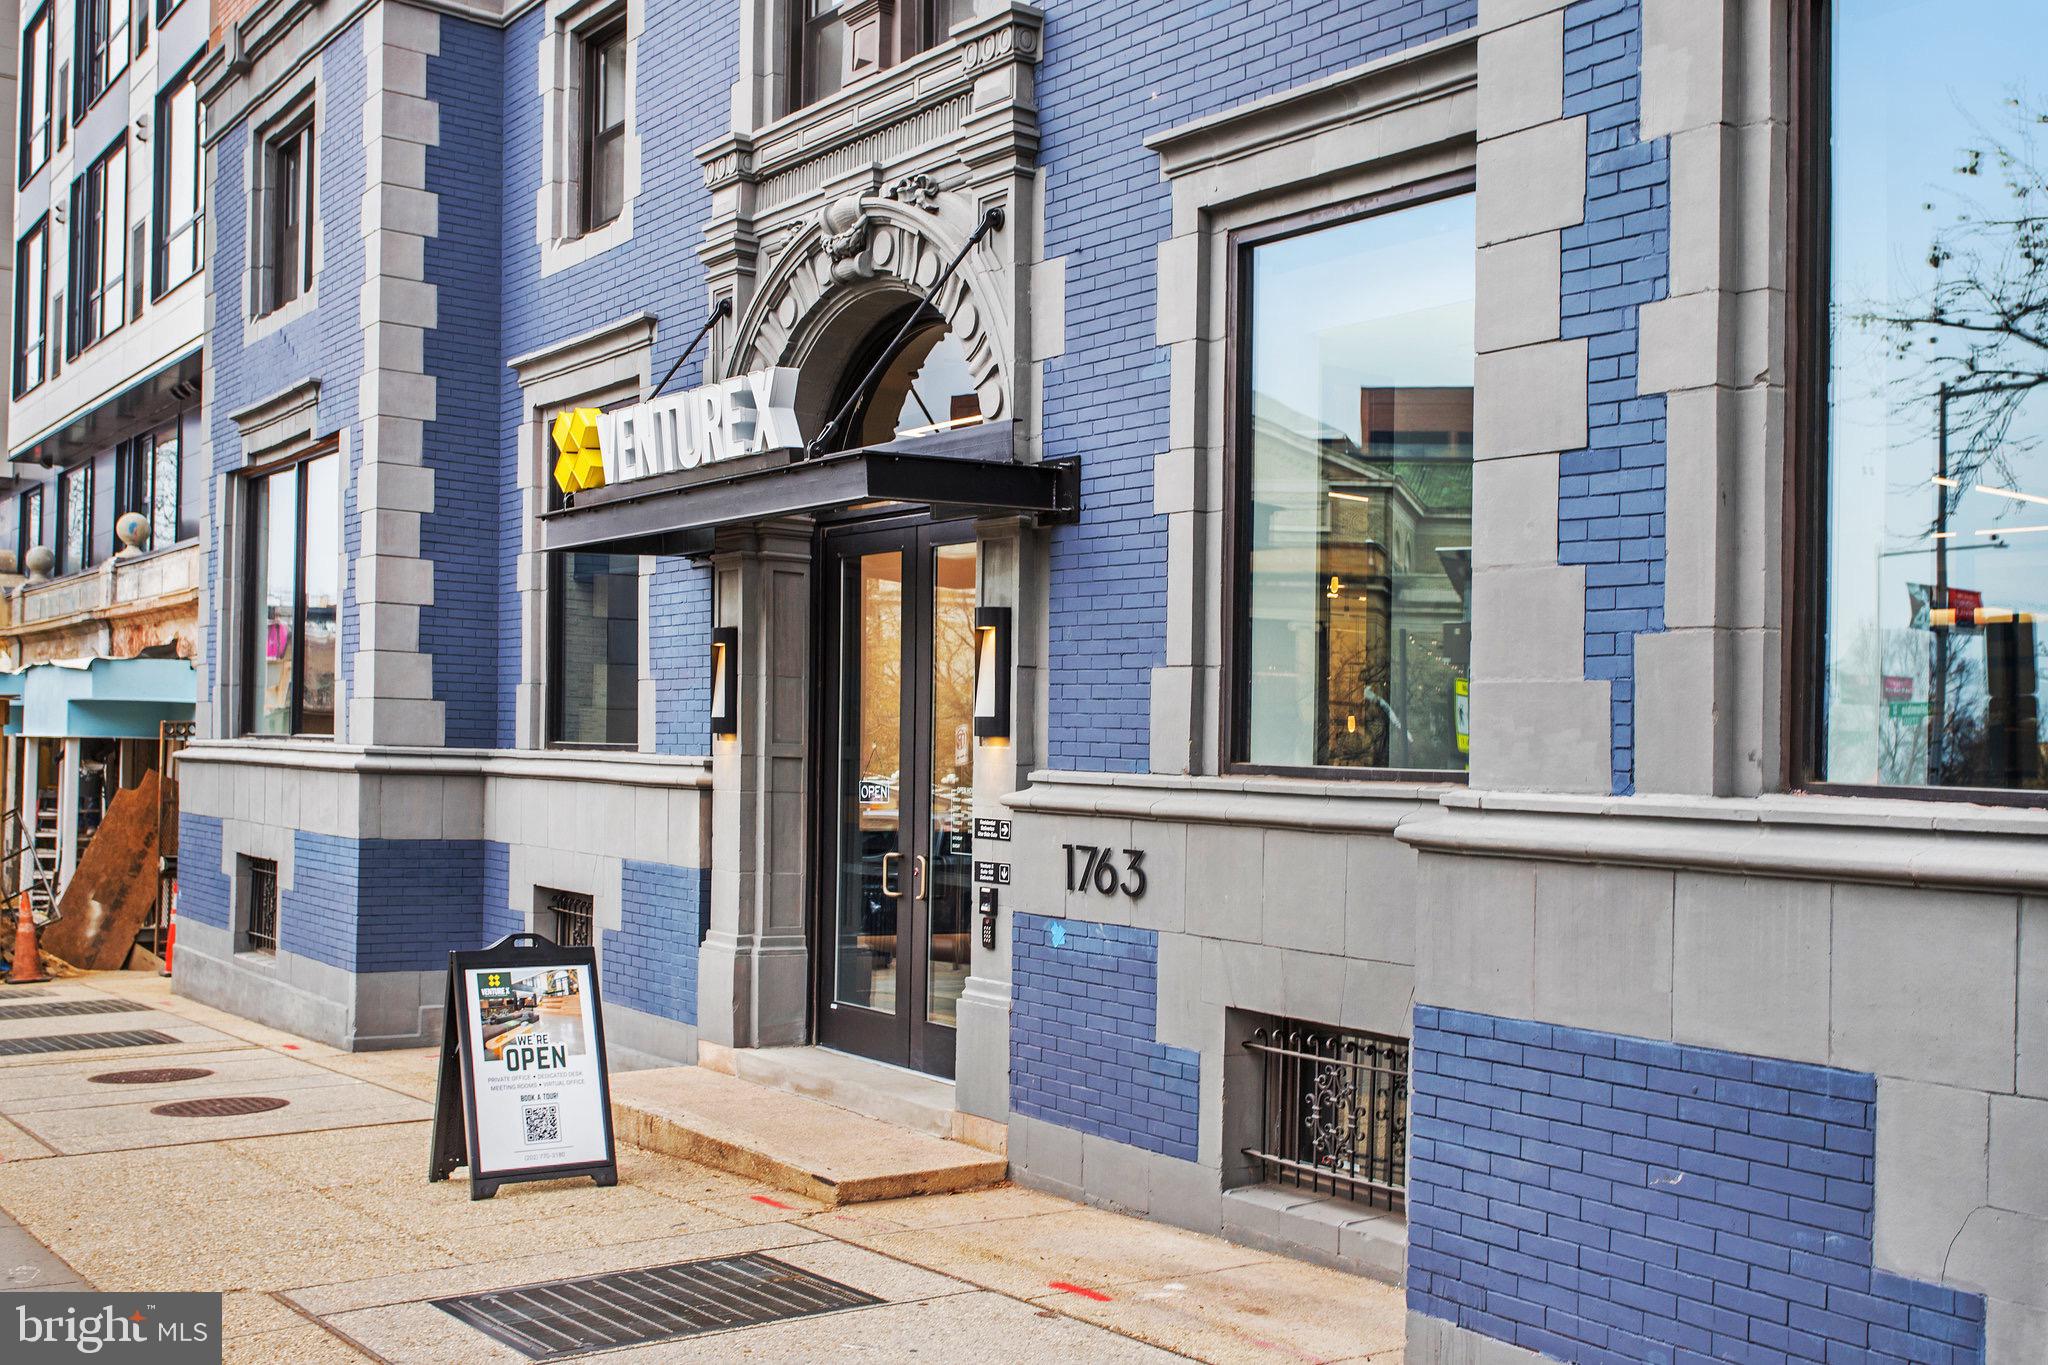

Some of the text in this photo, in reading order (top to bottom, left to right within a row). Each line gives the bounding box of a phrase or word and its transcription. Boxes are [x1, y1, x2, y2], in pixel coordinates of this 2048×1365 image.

[861, 785, 888, 798] OPEN
[1062, 844, 1147, 898] 1763
[517, 1033, 549, 1046] WE'RE
[506, 1045, 567, 1072] OPEN
[537, 1072, 567, 1080] DEDICATED
